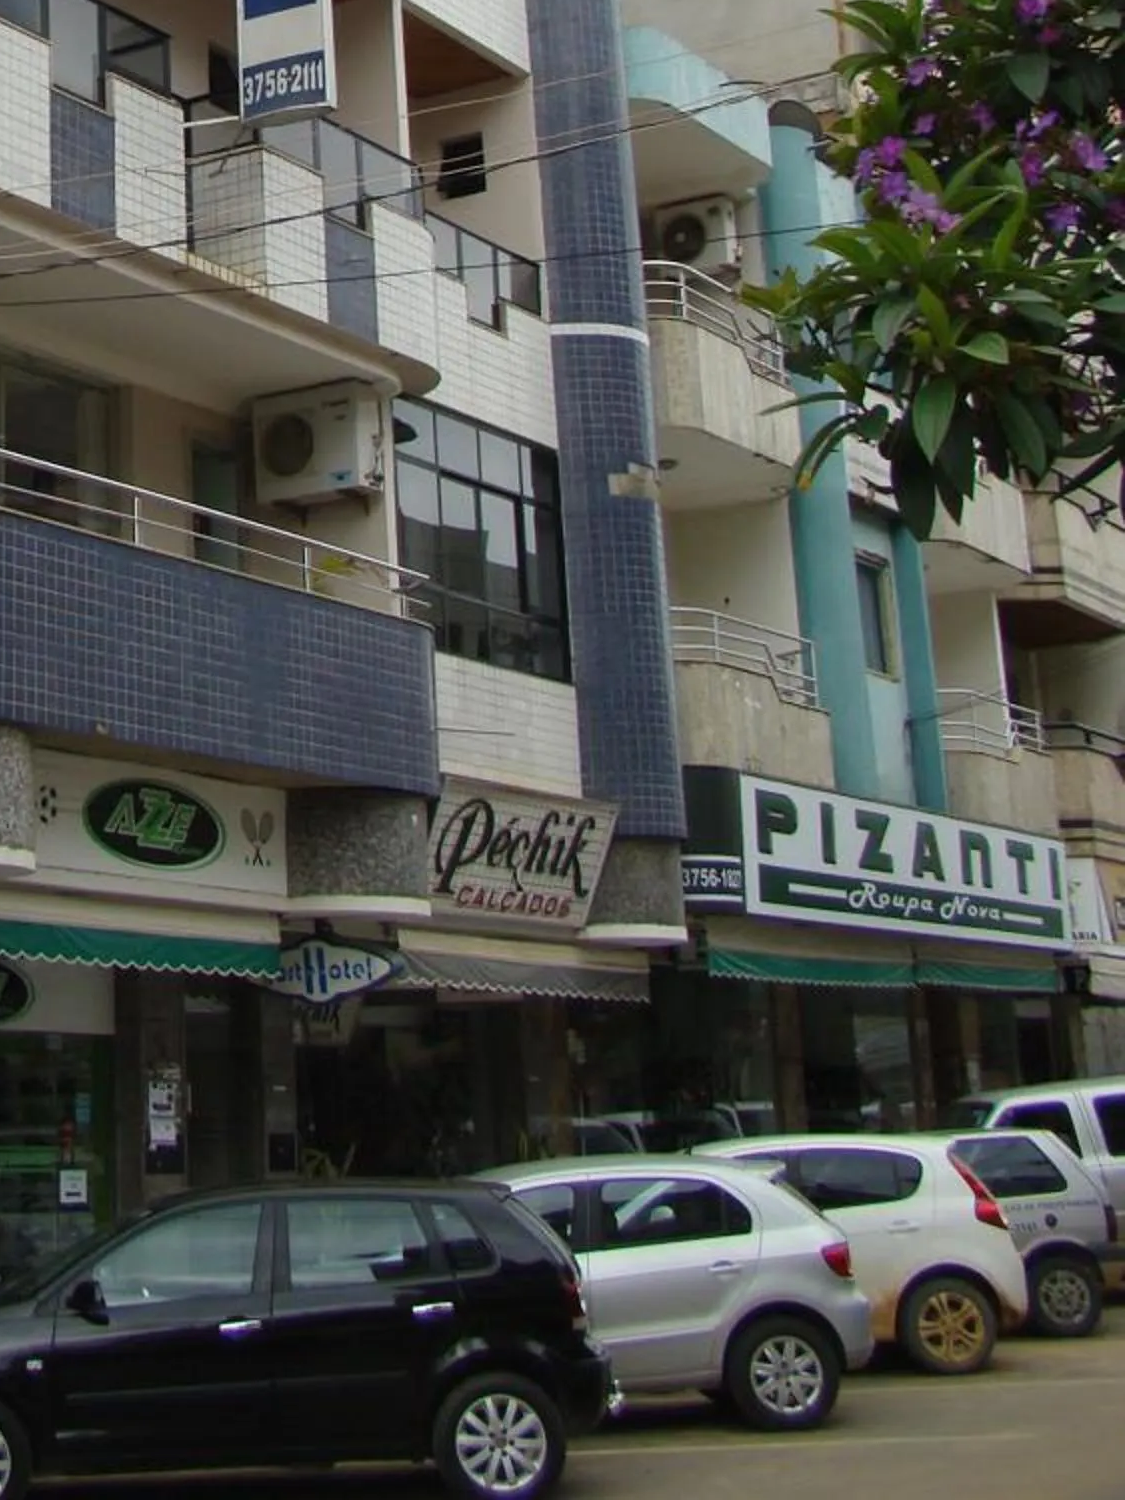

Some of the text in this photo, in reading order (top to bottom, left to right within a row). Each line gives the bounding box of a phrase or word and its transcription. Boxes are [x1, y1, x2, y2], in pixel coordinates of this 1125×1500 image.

[243, 59, 324, 105] 3756-2111
[755, 787, 1063, 901] PIZANTI
[848, 882, 1003, 921] Roupa Nova
